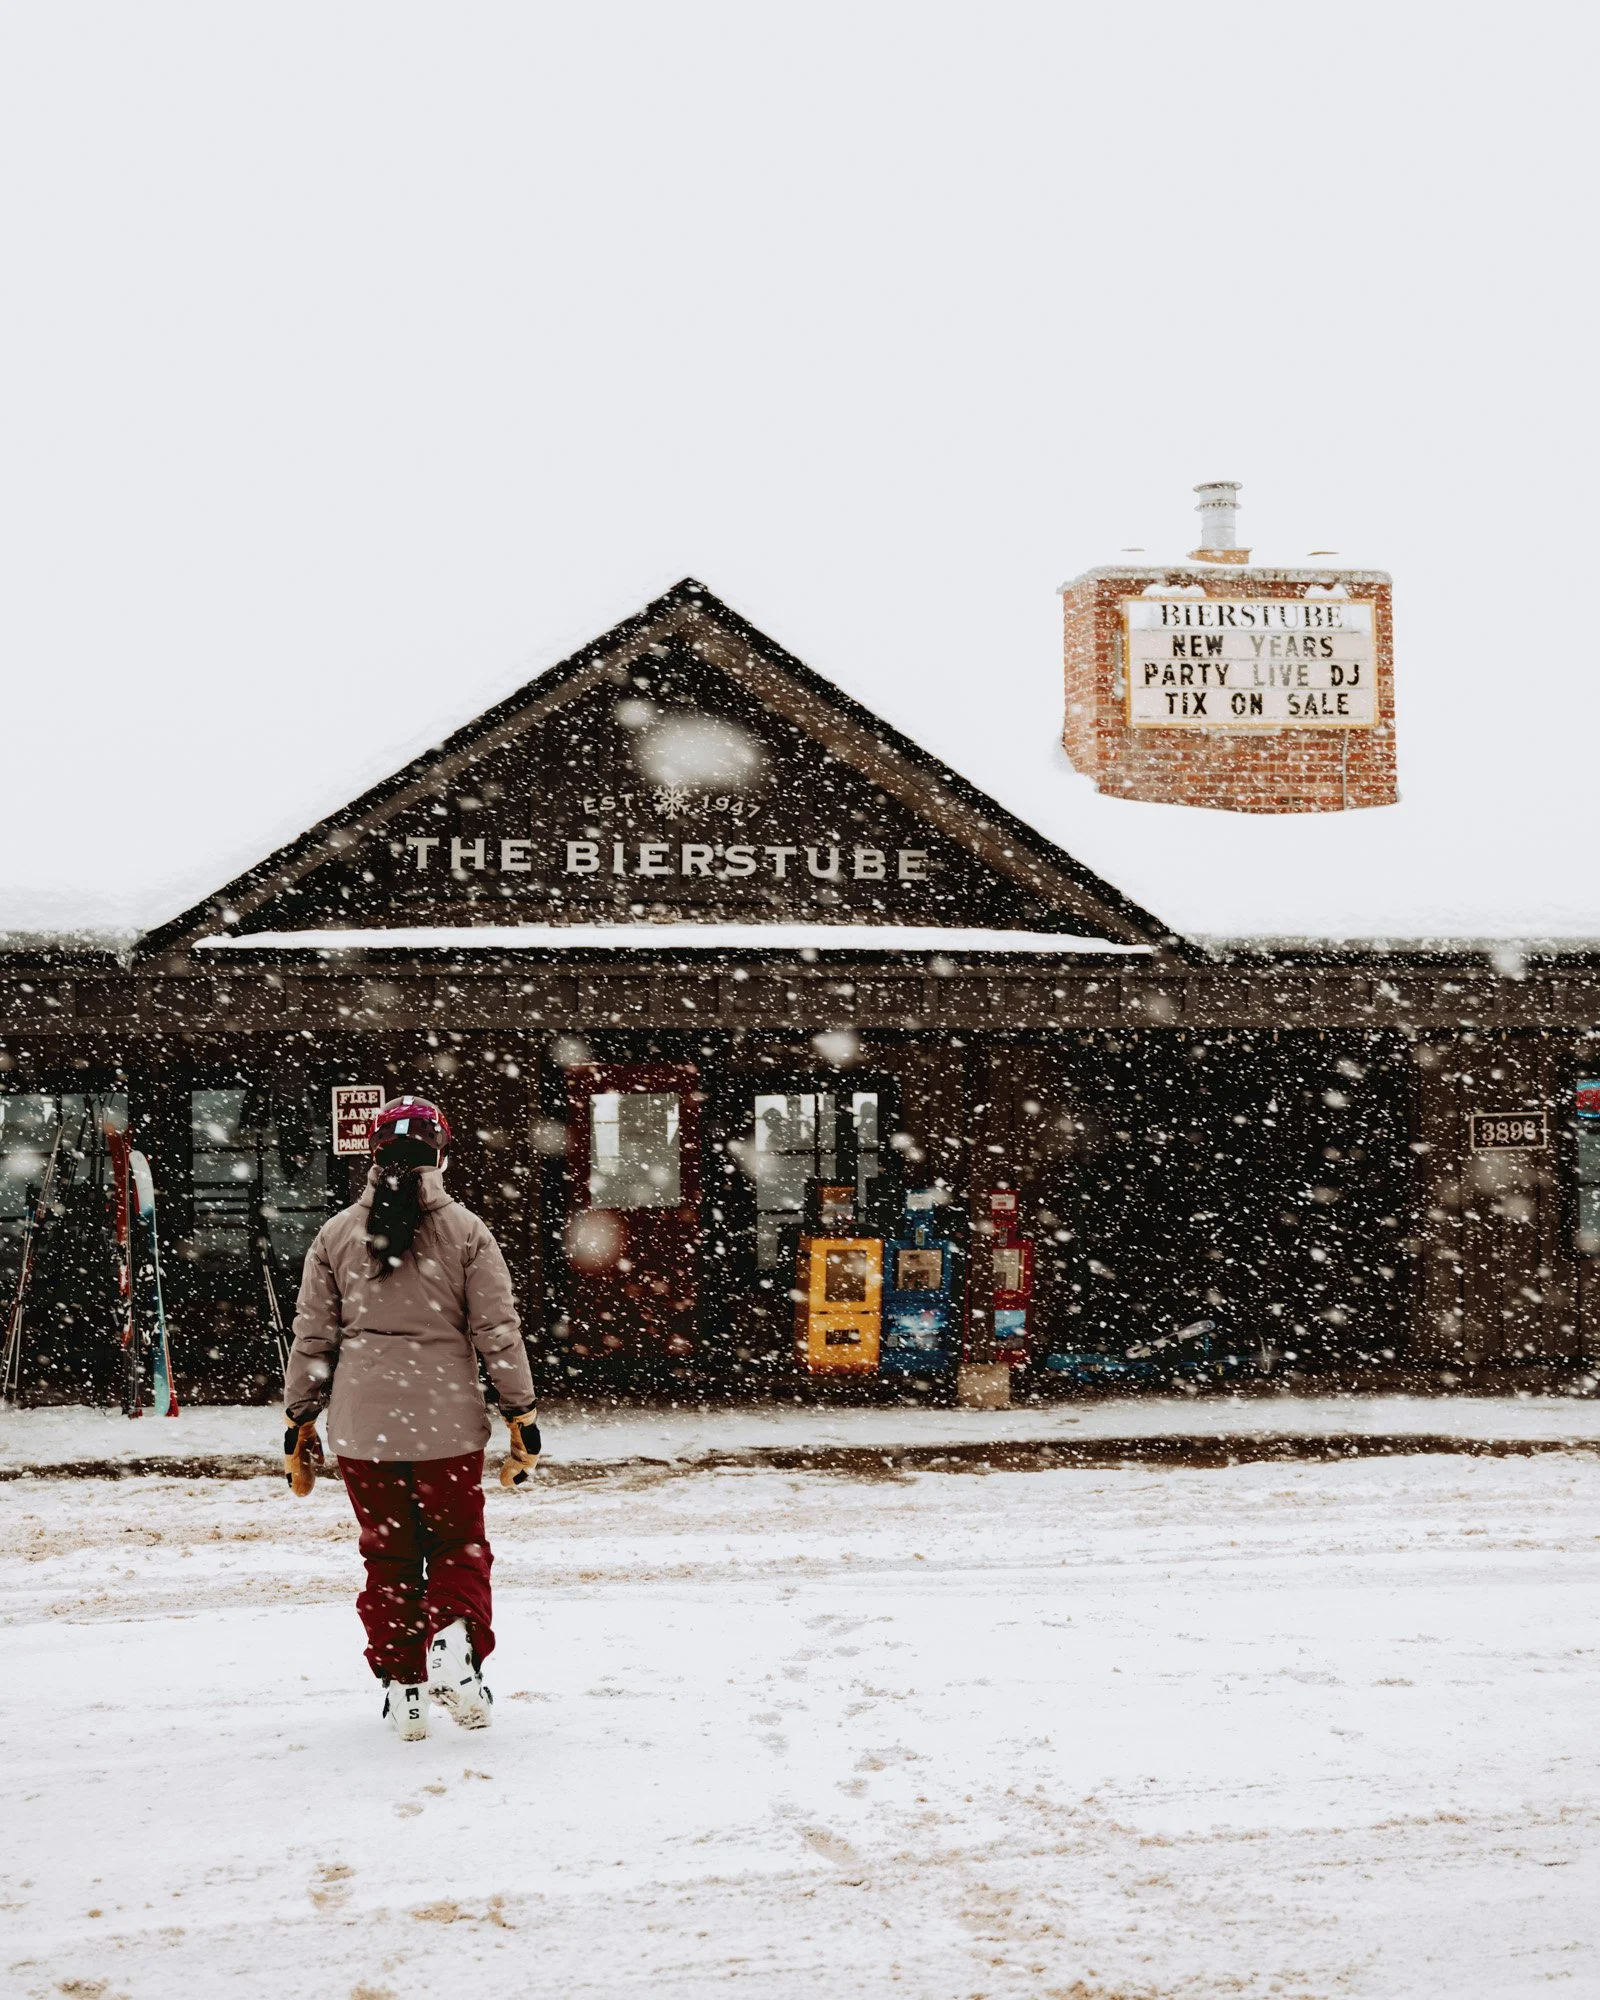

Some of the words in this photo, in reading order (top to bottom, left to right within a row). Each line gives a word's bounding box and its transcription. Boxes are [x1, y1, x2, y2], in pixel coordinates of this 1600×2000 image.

[1161, 604, 1344, 628] BIERSTUBE
[1172, 635, 1224, 658] NEW
[1250, 635, 1334, 658] YEARS
[1145, 663, 1229, 686] PARTY
[1254, 663, 1309, 687] LIVE
[1331, 664, 1360, 686] DJ
[1165, 692, 1208, 716] TIX
[1231, 692, 1263, 716] ON
[1288, 693, 1350, 716] SALE
[701, 794, 761, 819] 1947
[406, 836, 532, 871] THE
[567, 841, 928, 881] BIERSTUBE
[340, 1092, 378, 1104] FIRE
[352, 1124, 366, 1136] NO
